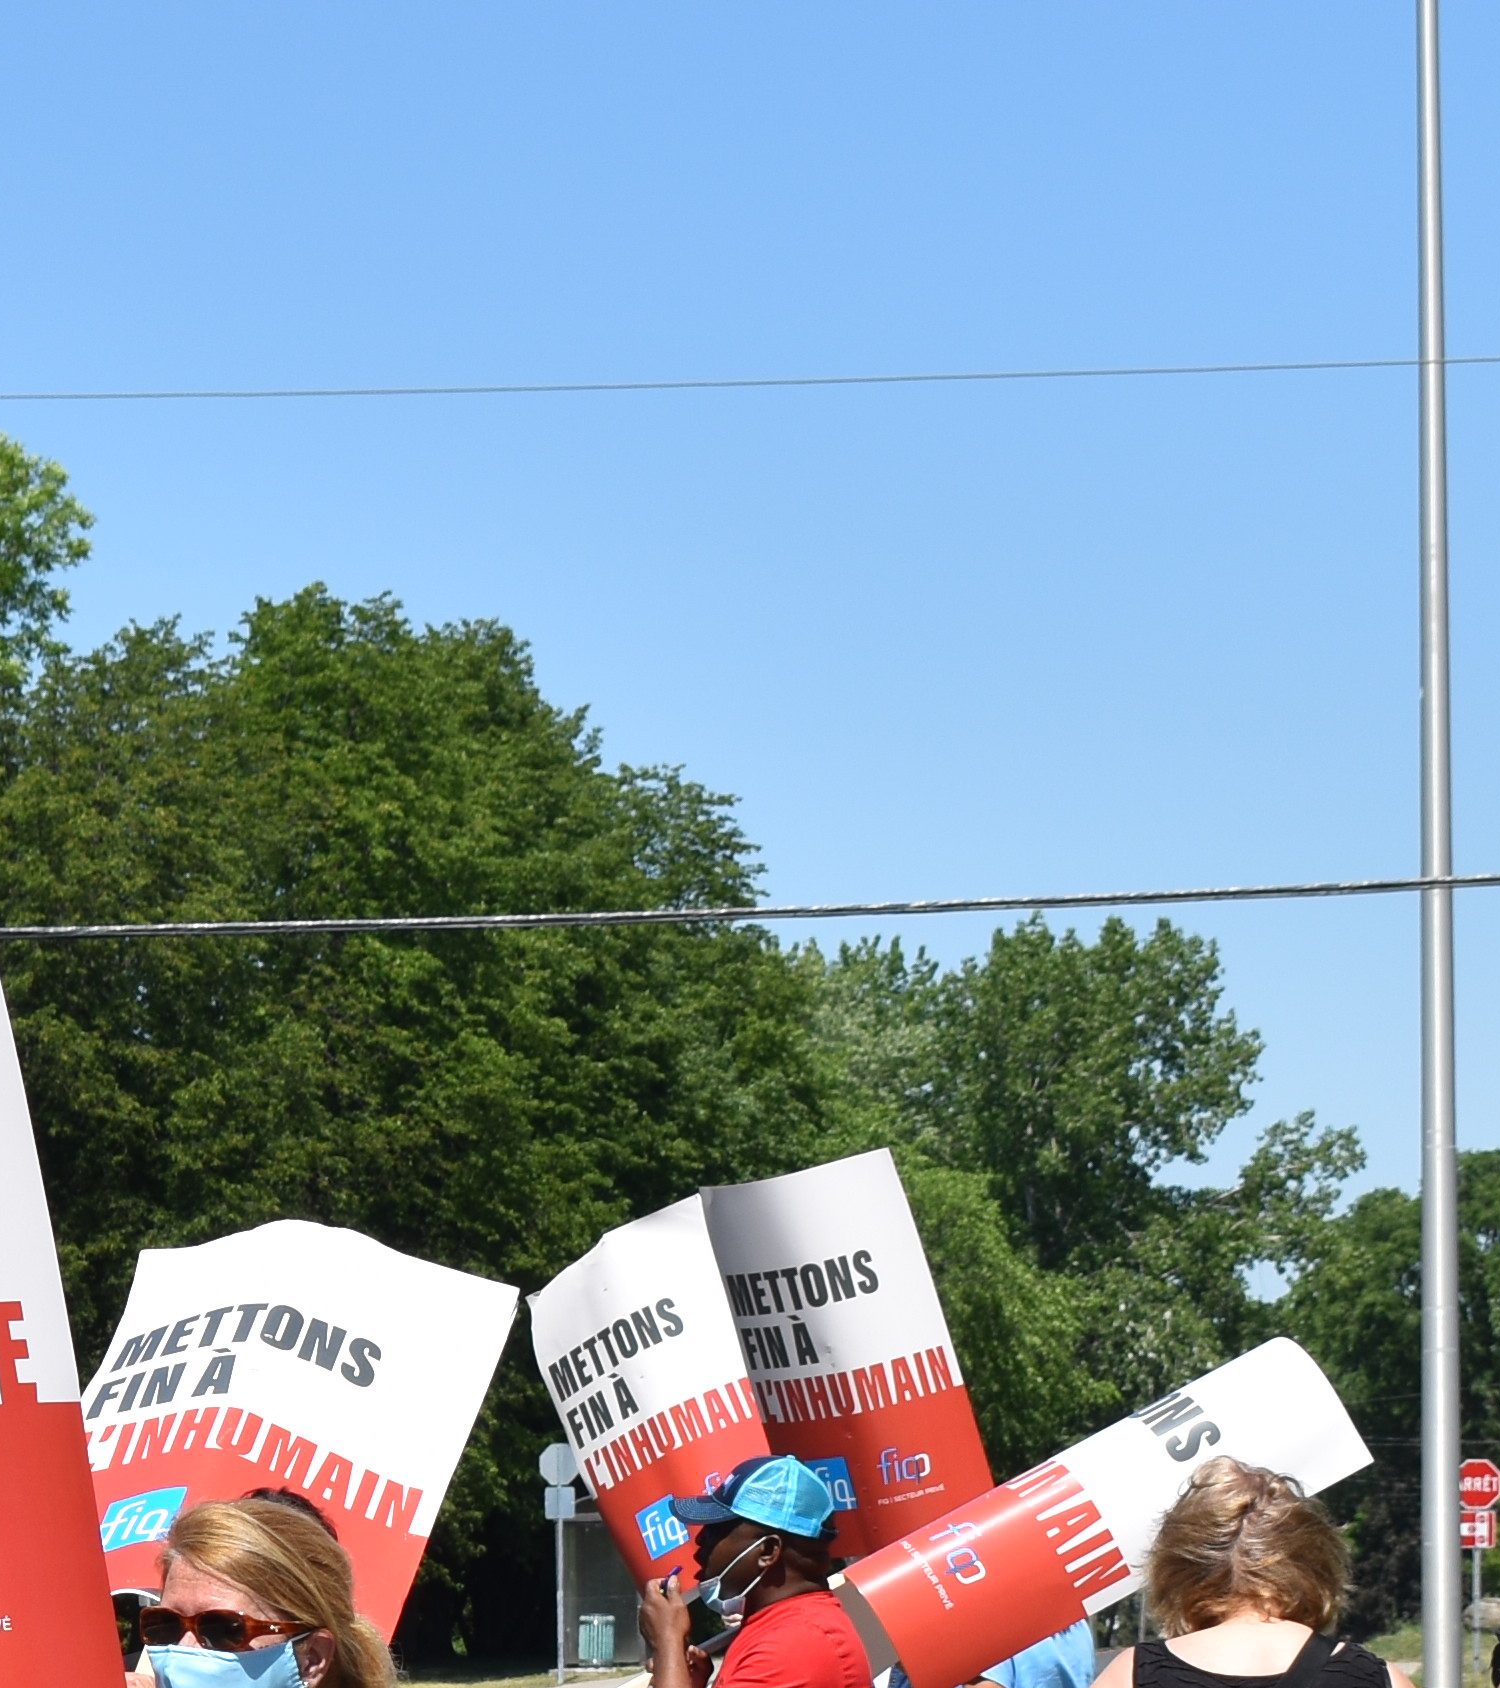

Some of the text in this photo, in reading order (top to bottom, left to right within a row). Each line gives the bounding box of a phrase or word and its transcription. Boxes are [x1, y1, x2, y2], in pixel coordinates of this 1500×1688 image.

[726, 1250, 879, 1318] METTONS
[110, 1303, 382, 1387] METTONS
[548, 1298, 684, 1402] METTONS
[741, 1315, 820, 1371] FIN À
[86, 1348, 236, 1420] FIN À
[566, 1373, 639, 1449] FIN À
[755, 1346, 952, 1424] L'INHUMAIN
